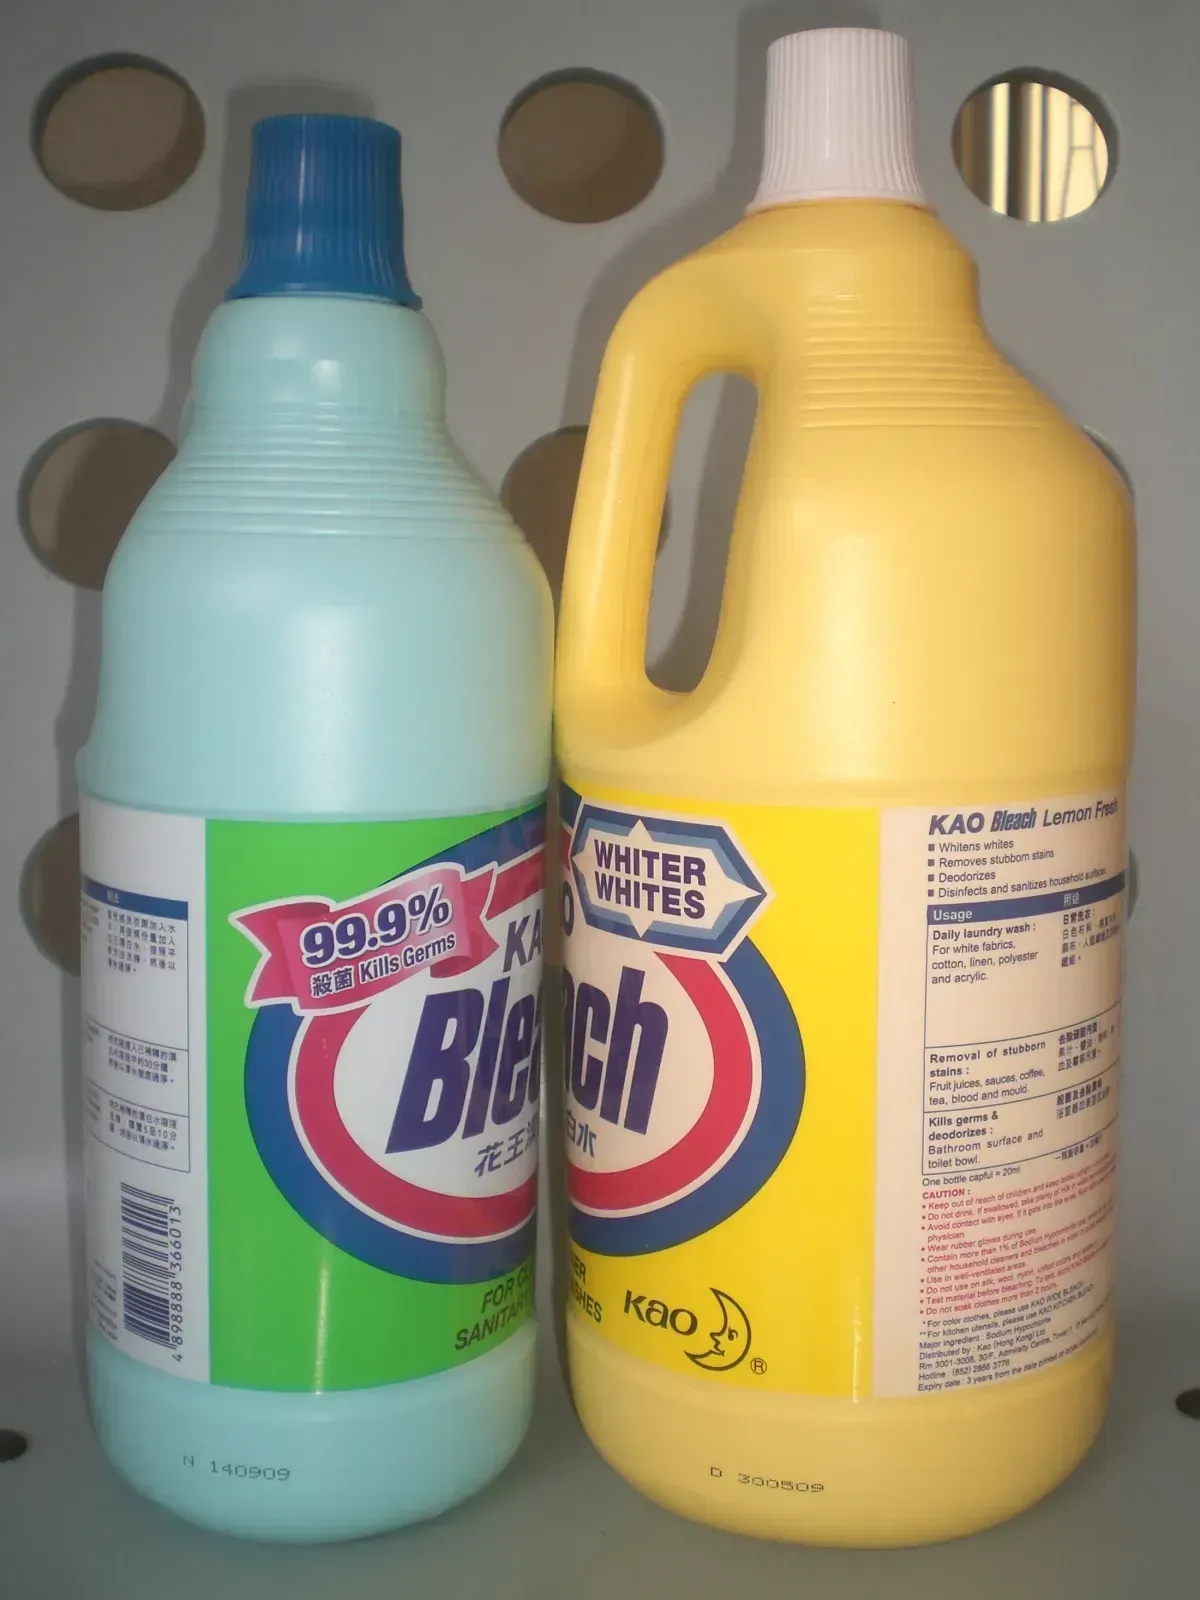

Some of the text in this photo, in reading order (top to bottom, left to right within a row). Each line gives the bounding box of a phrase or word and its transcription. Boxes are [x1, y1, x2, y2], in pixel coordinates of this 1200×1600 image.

[928, 798, 1119, 836] KAO Bleach Lemon Fresh
[939, 839, 1014, 853] Whitens whites
[593, 838, 707, 887] WHITER
[939, 849, 1055, 868] Removes stubborn stains
[938, 872, 1084, 898] Disinfects and sanitizes household
[939, 871, 996, 884] Deodorizes
[594, 870, 706, 920] WHITES
[303, 887, 450, 965] 99.9%
[933, 909, 973, 922] Usage
[501, 913, 543, 973] KA
[933, 923, 1031, 942] Daily laundry wash
[932, 938, 1016, 956] For white fabrics,
[312, 932, 456, 998] 殺菌 Kills Germs
[931, 950, 1039, 971] cotton, linen, polyester
[931, 970, 989, 985] and acrylic.
[930, 1041, 1046, 1064] Removal of stubborn
[929, 1066, 963, 1078] stains
[929, 1068, 1045, 1092] Fruit juices, sauces, coffee,
[929, 1089, 999, 1107] tea, blood and
[929, 1110, 999, 1127] Kills germs &
[928, 1126, 987, 1141] deodorizes
[928, 1127, 1044, 1156] Bathroom surface and
[928, 1154, 980, 1170] toilet bowl.
[922, 1169, 994, 1187] One bottle capful
[922, 1188, 965, 1200] CAUTION
[928, 1185, 1031, 1212] Keep out of reach children
[927, 1201, 1020, 1221] Do not drink. swallowed,
[927, 1214, 996, 1232] Avoid contact with
[927, 1232, 966, 1244] physician.
[928, 1230, 1023, 1253] Wear rubber gloves during
[927, 1245, 997, 1263] Contain more than
[927, 1252, 1019, 1275] other household cleaners
[168, 1205, 184, 1362] 4 898888 366013
[926, 1266, 1006, 1284] Use in well-ventilated
[481, 1276, 514, 1316] FOR
[926, 1280, 980, 1295] Do not use on
[926, 1287, 1000, 1305] Test material before
[926, 1294, 1019, 1316] Do not soak clothes more
[942, 1297, 1045, 1327] color clothes, please use KAO
[942, 1306, 1052, 1337] kitchen utensils, please use KAO
[919, 1329, 1012, 1350] Major Sodium
[919, 1332, 1035, 1361] Distributed by Kao (Hong Kong)
[919, 1362, 933, 1371] Rm
[998, 1344, 1029, 1358] Admiralty
[918, 1362, 1038, 1392] Expiry date years from the date
[919, 1365, 972, 1382] Hotline (852)
[182, 1455, 291, 1481] N 140909
[737, 1473, 825, 1493] 300509
